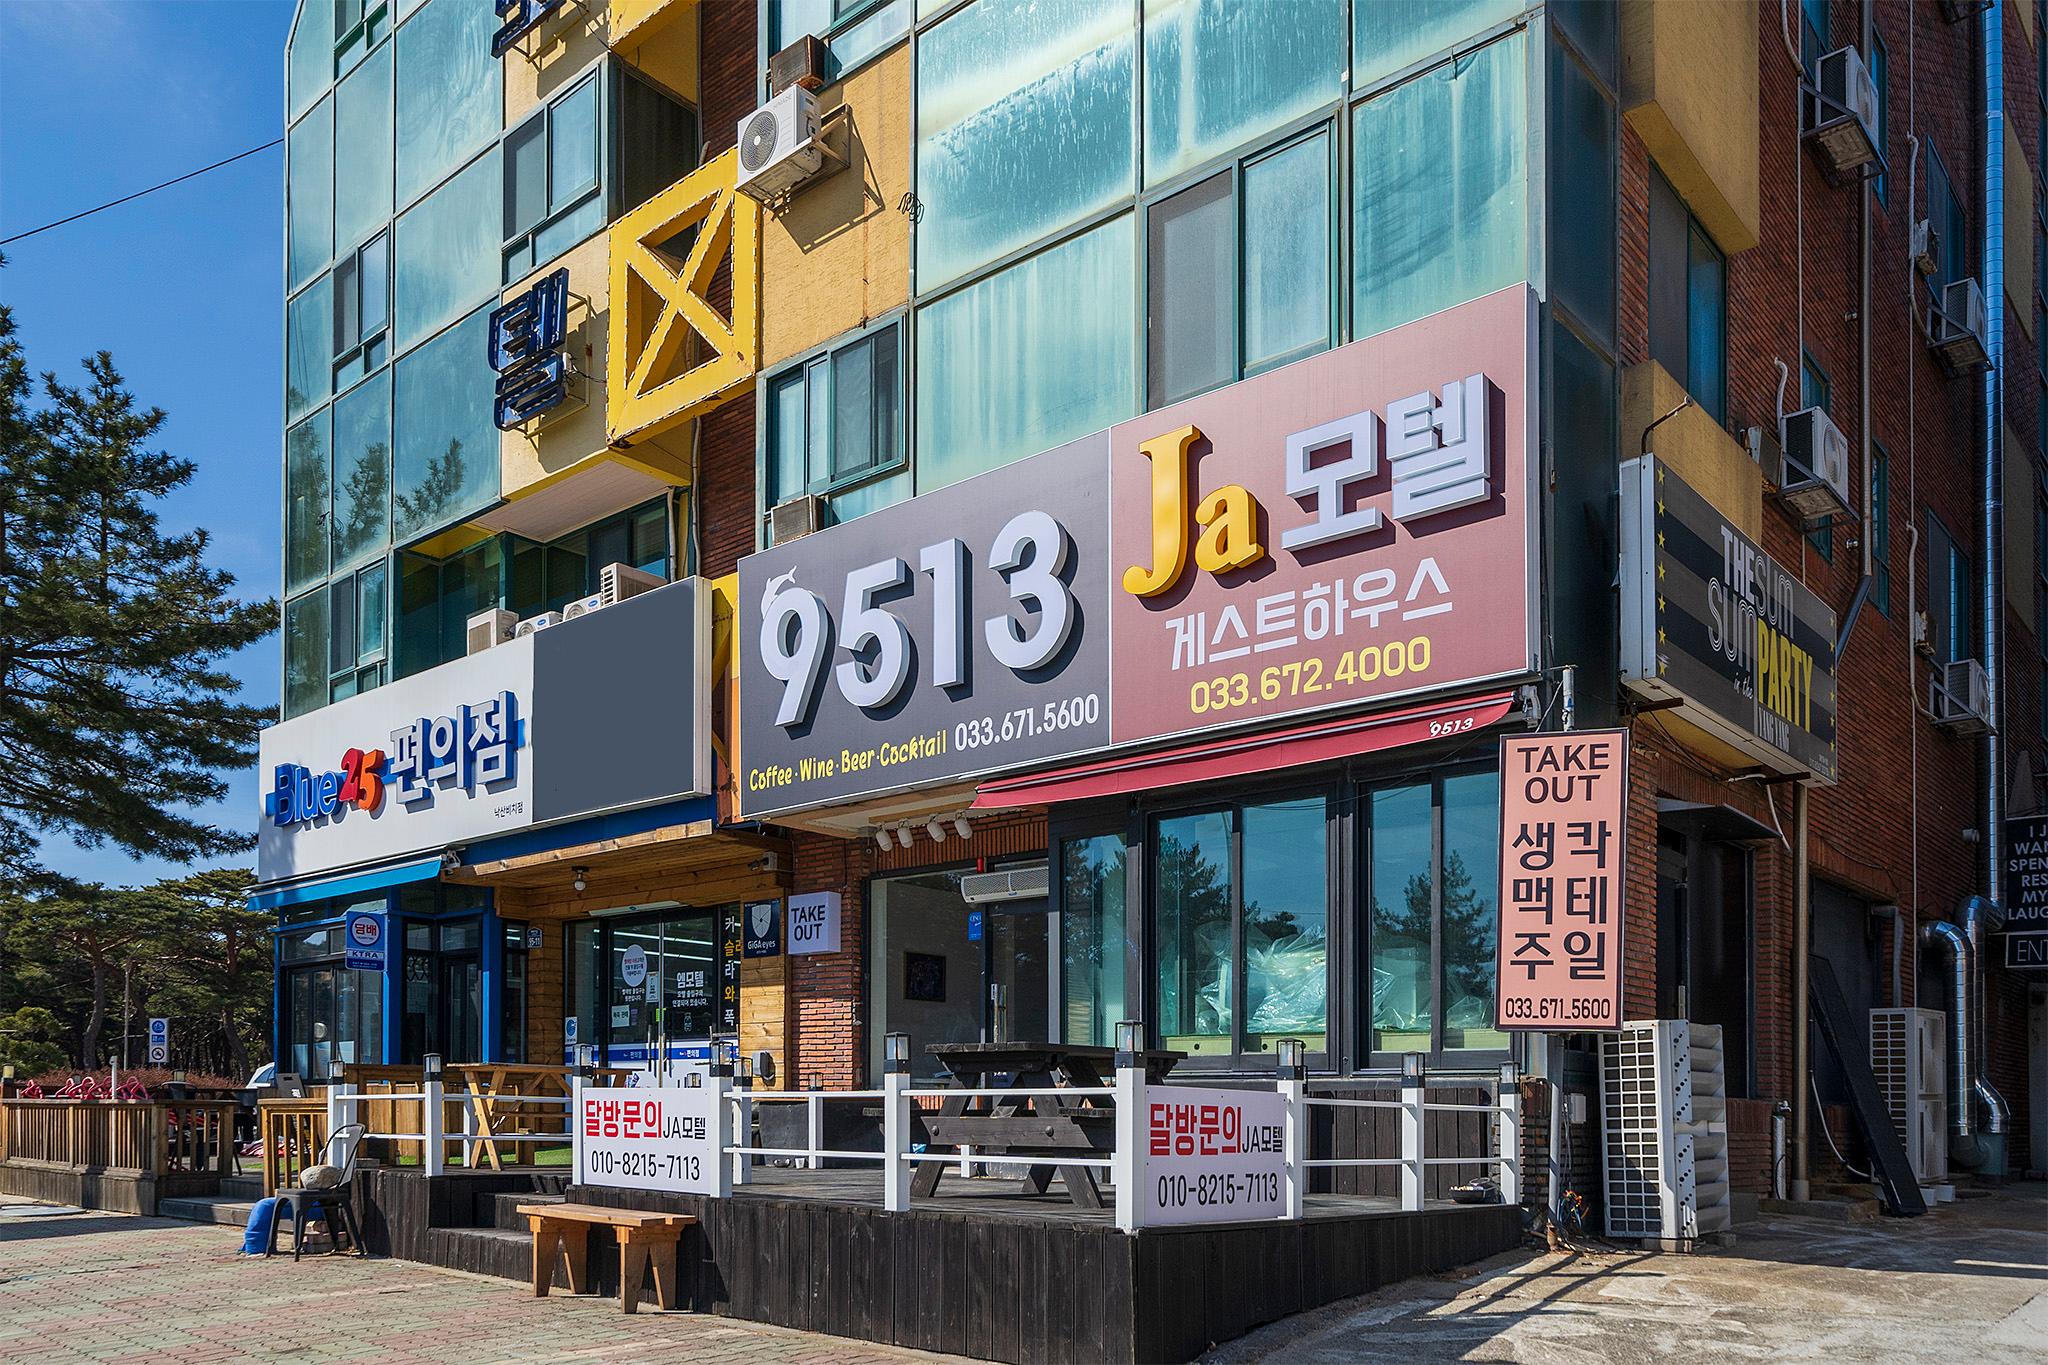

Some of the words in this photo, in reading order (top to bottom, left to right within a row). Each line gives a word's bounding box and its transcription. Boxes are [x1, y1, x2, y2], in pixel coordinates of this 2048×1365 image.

[1122, 424, 1264, 597] Ja
[1281, 372, 1491, 551] 모텔
[760, 510, 1076, 728] 9513
[1165, 557, 1453, 671] 게스트하우스
[1190, 635, 1431, 715] 033.672.4000
[1757, 617, 1813, 734] PARTY
[954, 693, 1099, 753] 033.671.5600
[1430, 717, 1474, 738] 9513
[390, 690, 519, 805] 편의점
[1517, 743, 1609, 774] TAKE
[1524, 774, 1600, 804] OUT
[355, 923, 377, 936] 담배
[791, 905, 825, 923] TAKE
[794, 923, 822, 941] OUT
[352, 951, 378, 959] KTRA
[591, 1150, 700, 1181] 010-8215-7113
[1158, 1172, 1278, 1208] 010-8215-7113
